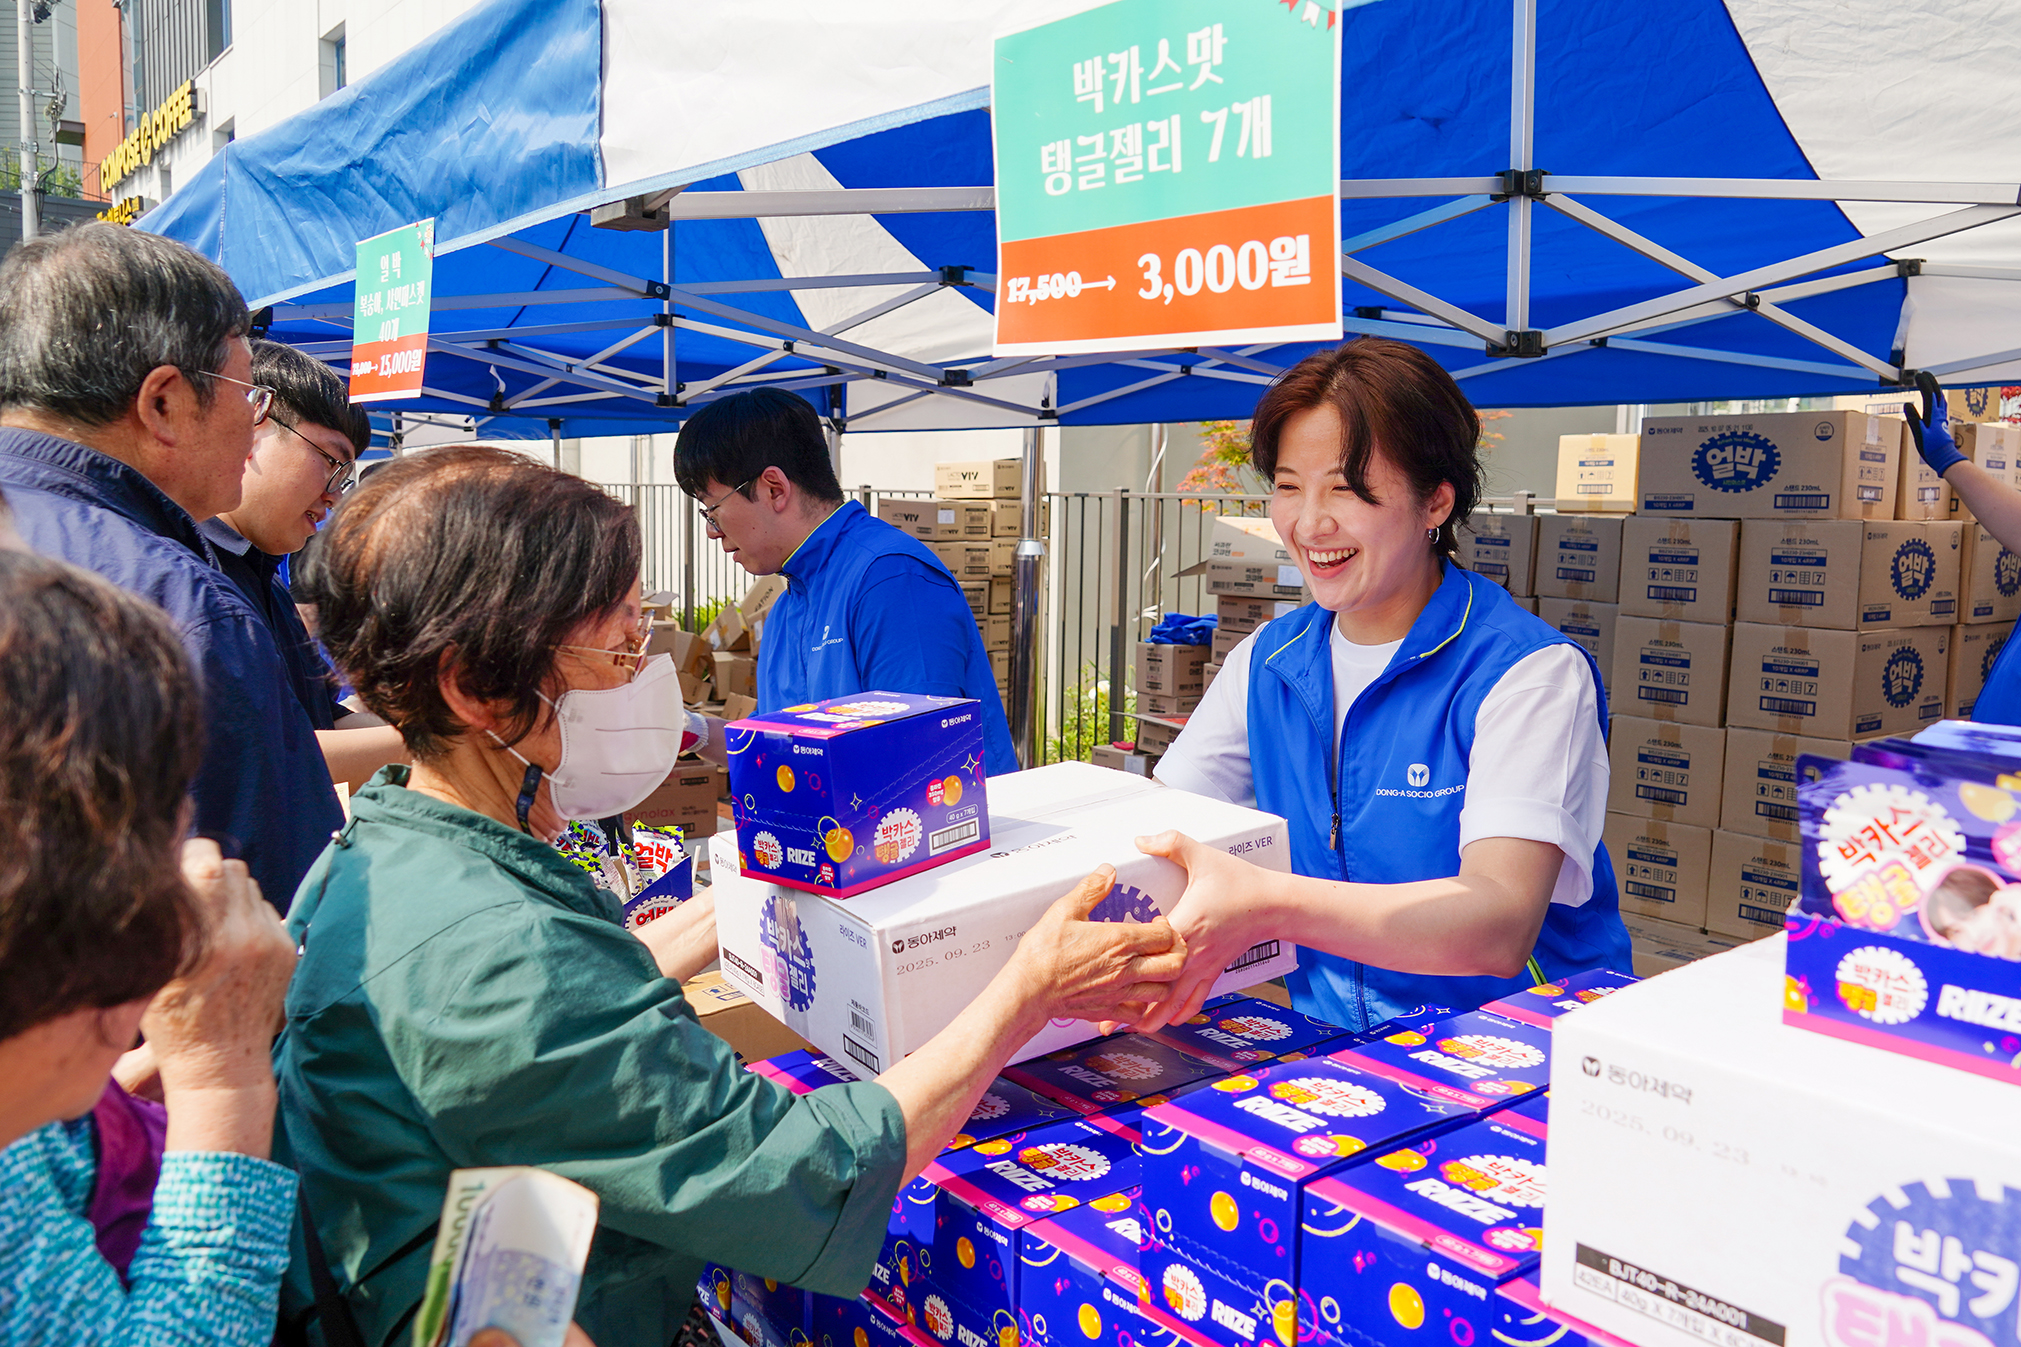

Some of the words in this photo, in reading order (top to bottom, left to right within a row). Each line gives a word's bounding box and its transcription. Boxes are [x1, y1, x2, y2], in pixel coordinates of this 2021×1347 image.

[1073, 23, 1228, 114] 박카스맛
[101, 127, 141, 193] COMPOSE
[152, 79, 193, 150] COFFEE
[1041, 114, 1183, 196] 탱글젤리
[1200, 94, 1272, 163] 7개
[1137, 234, 1311, 306] 3,000원
[1007, 271, 1083, 306] 17,500
[378, 317, 401, 342] 40개
[378, 348, 423, 379] 15,000원
[1705, 445, 1766, 479] 얼박
[1801, 484, 1821, 492] 230mL
[1898, 552, 1930, 587] 얼박
[1789, 647, 1811, 656] 230mL
[1889, 659, 1918, 695] 얼박
[949, 713, 971, 727] 동아제약
[800, 745, 823, 756] 동아제약
[1375, 788, 1406, 797] DONG-A
[1406, 791, 1434, 799] SOCIO
[1434, 784, 1465, 798] GROUP
[623, 808, 676, 825] gynolax
[882, 820, 914, 841] 박카스
[757, 840, 777, 853] 박카스
[876, 841, 899, 864] 탱글
[899, 835, 915, 850] 젤리
[1228, 841, 1254, 857] 라이즈
[1255, 836, 1273, 849] VER
[1837, 806, 1924, 866] 박카스
[633, 841, 674, 874] 얼박
[755, 850, 770, 865] 탱글
[787, 847, 816, 867] RIIZE
[1834, 862, 1922, 928] 탱글
[1904, 828, 1951, 870] 젤리
[767, 917, 806, 968] 박카스
[839, 924, 856, 943] 라이즈
[855, 936, 867, 949] VER
[908, 926, 957, 949] 동아제약
[761, 946, 790, 999] 탱글
[788, 963, 809, 996] 젤리
[896, 957, 939, 976] 2025.
[944, 948, 967, 961] 09.
[972, 940, 991, 953] 23
[1854, 962, 1911, 994] 박카스
[1838, 983, 1878, 1012] 탱글
[1195, 1027, 1254, 1050] RIIZE
[1246, 1018, 1287, 1037] 박카스
[1408, 1049, 1498, 1079] RIIZE
[1475, 1038, 1530, 1062] 박카스
[1057, 1064, 1118, 1088] RIIZE
[1112, 1055, 1152, 1076] 박카스
[1309, 1082, 1366, 1109] 박카스
[1608, 1062, 1694, 1106] 동아제약
[1233, 1095, 1328, 1133] RIIZE
[1580, 1100, 1652, 1136] 2025.
[1662, 1125, 1702, 1153] 09.
[1711, 1140, 1750, 1167] 23
[1021, 1147, 1057, 1170] 탱글
[1055, 1164, 1082, 1178] 젤리
[1053, 1147, 1096, 1173] 박카스
[985, 1160, 1056, 1193] RIIZE
[1250, 1180, 1289, 1202] 동아제약
[1404, 1177, 1518, 1226] RIIZE
[1170, 1273, 1199, 1301] 박카스
[1442, 1268, 1487, 1301] 동아제약
[1607, 1257, 1749, 1330] BJT40-R-24A001
[928, 1302, 950, 1325] 박카스
[1210, 1298, 1258, 1342] RIIZE
